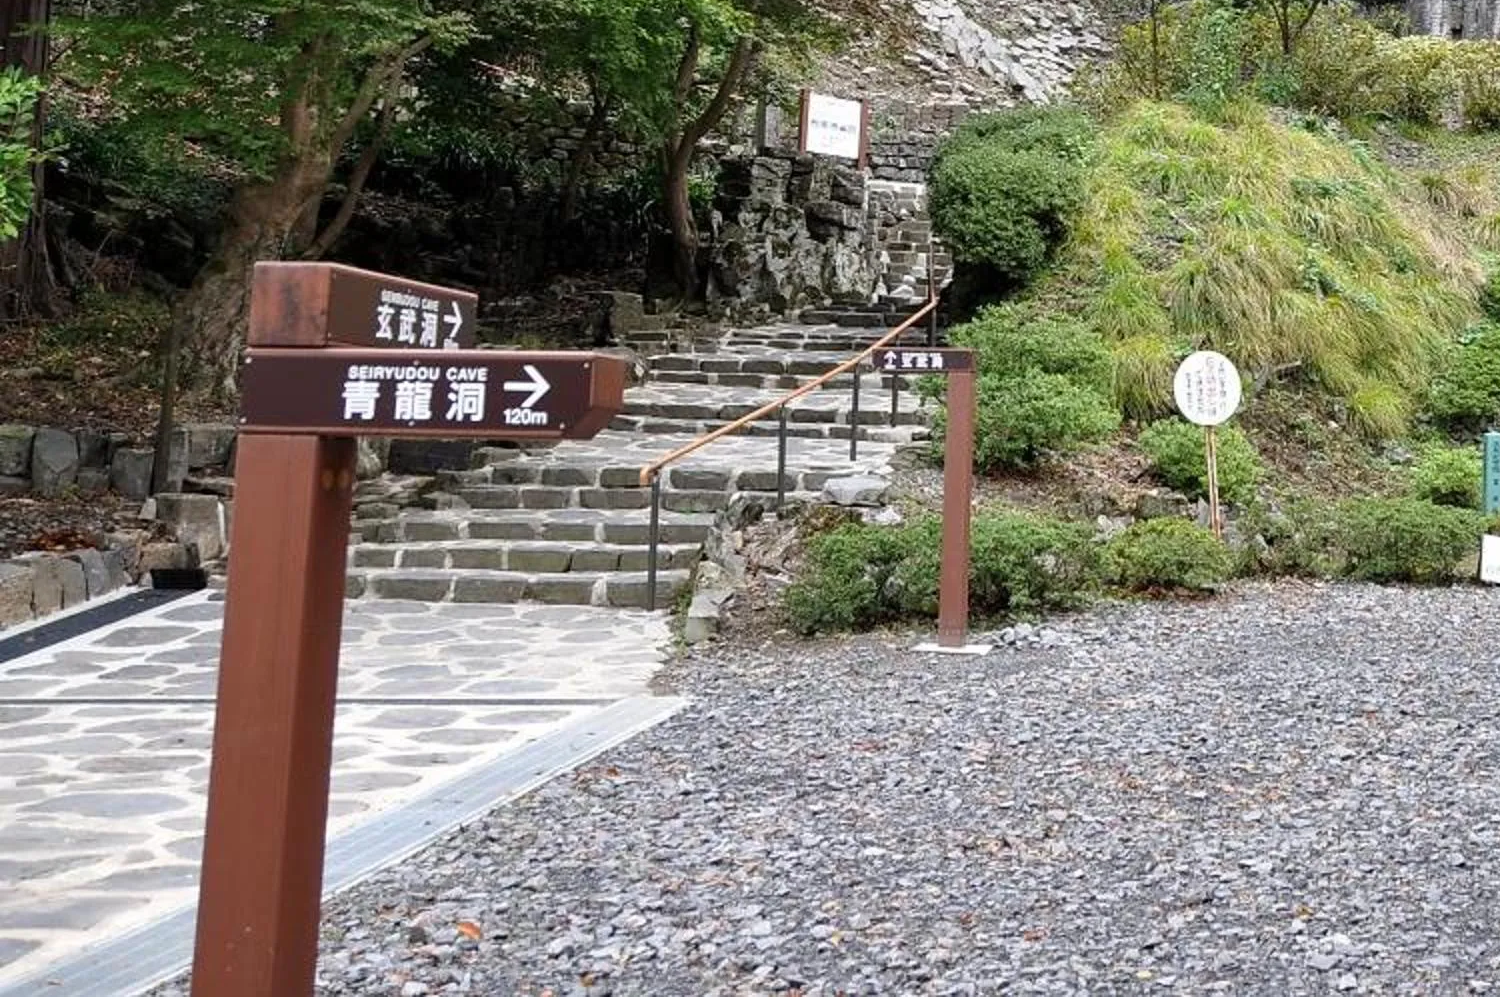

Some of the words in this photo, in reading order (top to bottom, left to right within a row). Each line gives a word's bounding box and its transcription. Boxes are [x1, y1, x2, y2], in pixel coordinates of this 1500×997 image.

[376, 304, 438, 348] 玄武洞
[348, 365, 440, 380] SEIRYUDOU
[446, 367, 488, 381] CAVE
[342, 381, 486, 421] 青龍洞
[503, 408, 548, 425] 120m
